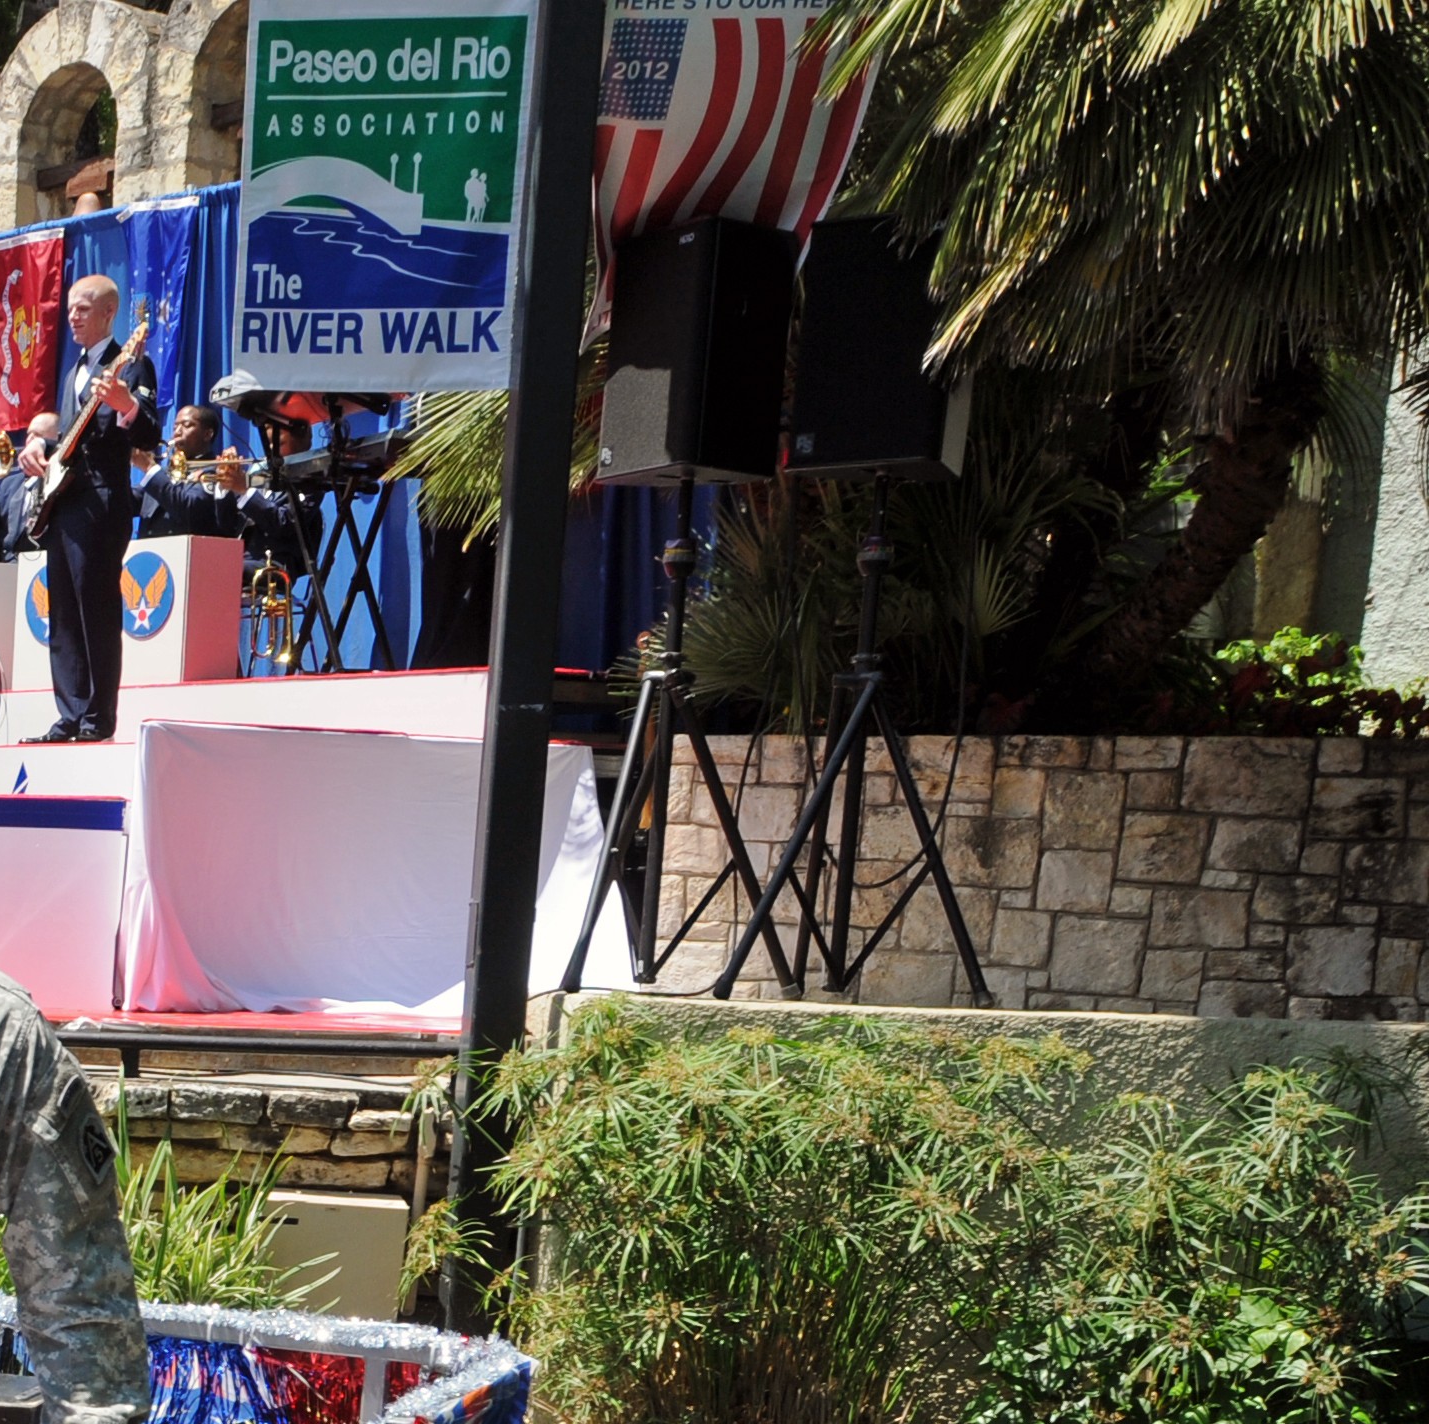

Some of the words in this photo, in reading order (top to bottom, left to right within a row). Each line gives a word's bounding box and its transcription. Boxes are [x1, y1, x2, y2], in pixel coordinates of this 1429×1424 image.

[615, 0, 698, 9] HERES
[268, 40, 377, 83] Paseo
[387, 38, 441, 82] del
[452, 36, 511, 80] Rio
[612, 60, 670, 80] 2012
[266, 111, 505, 137] ASSOCIATION
[252, 264, 302, 303] The
[241, 311, 364, 354] RIVER
[380, 310, 503, 354] WALK
